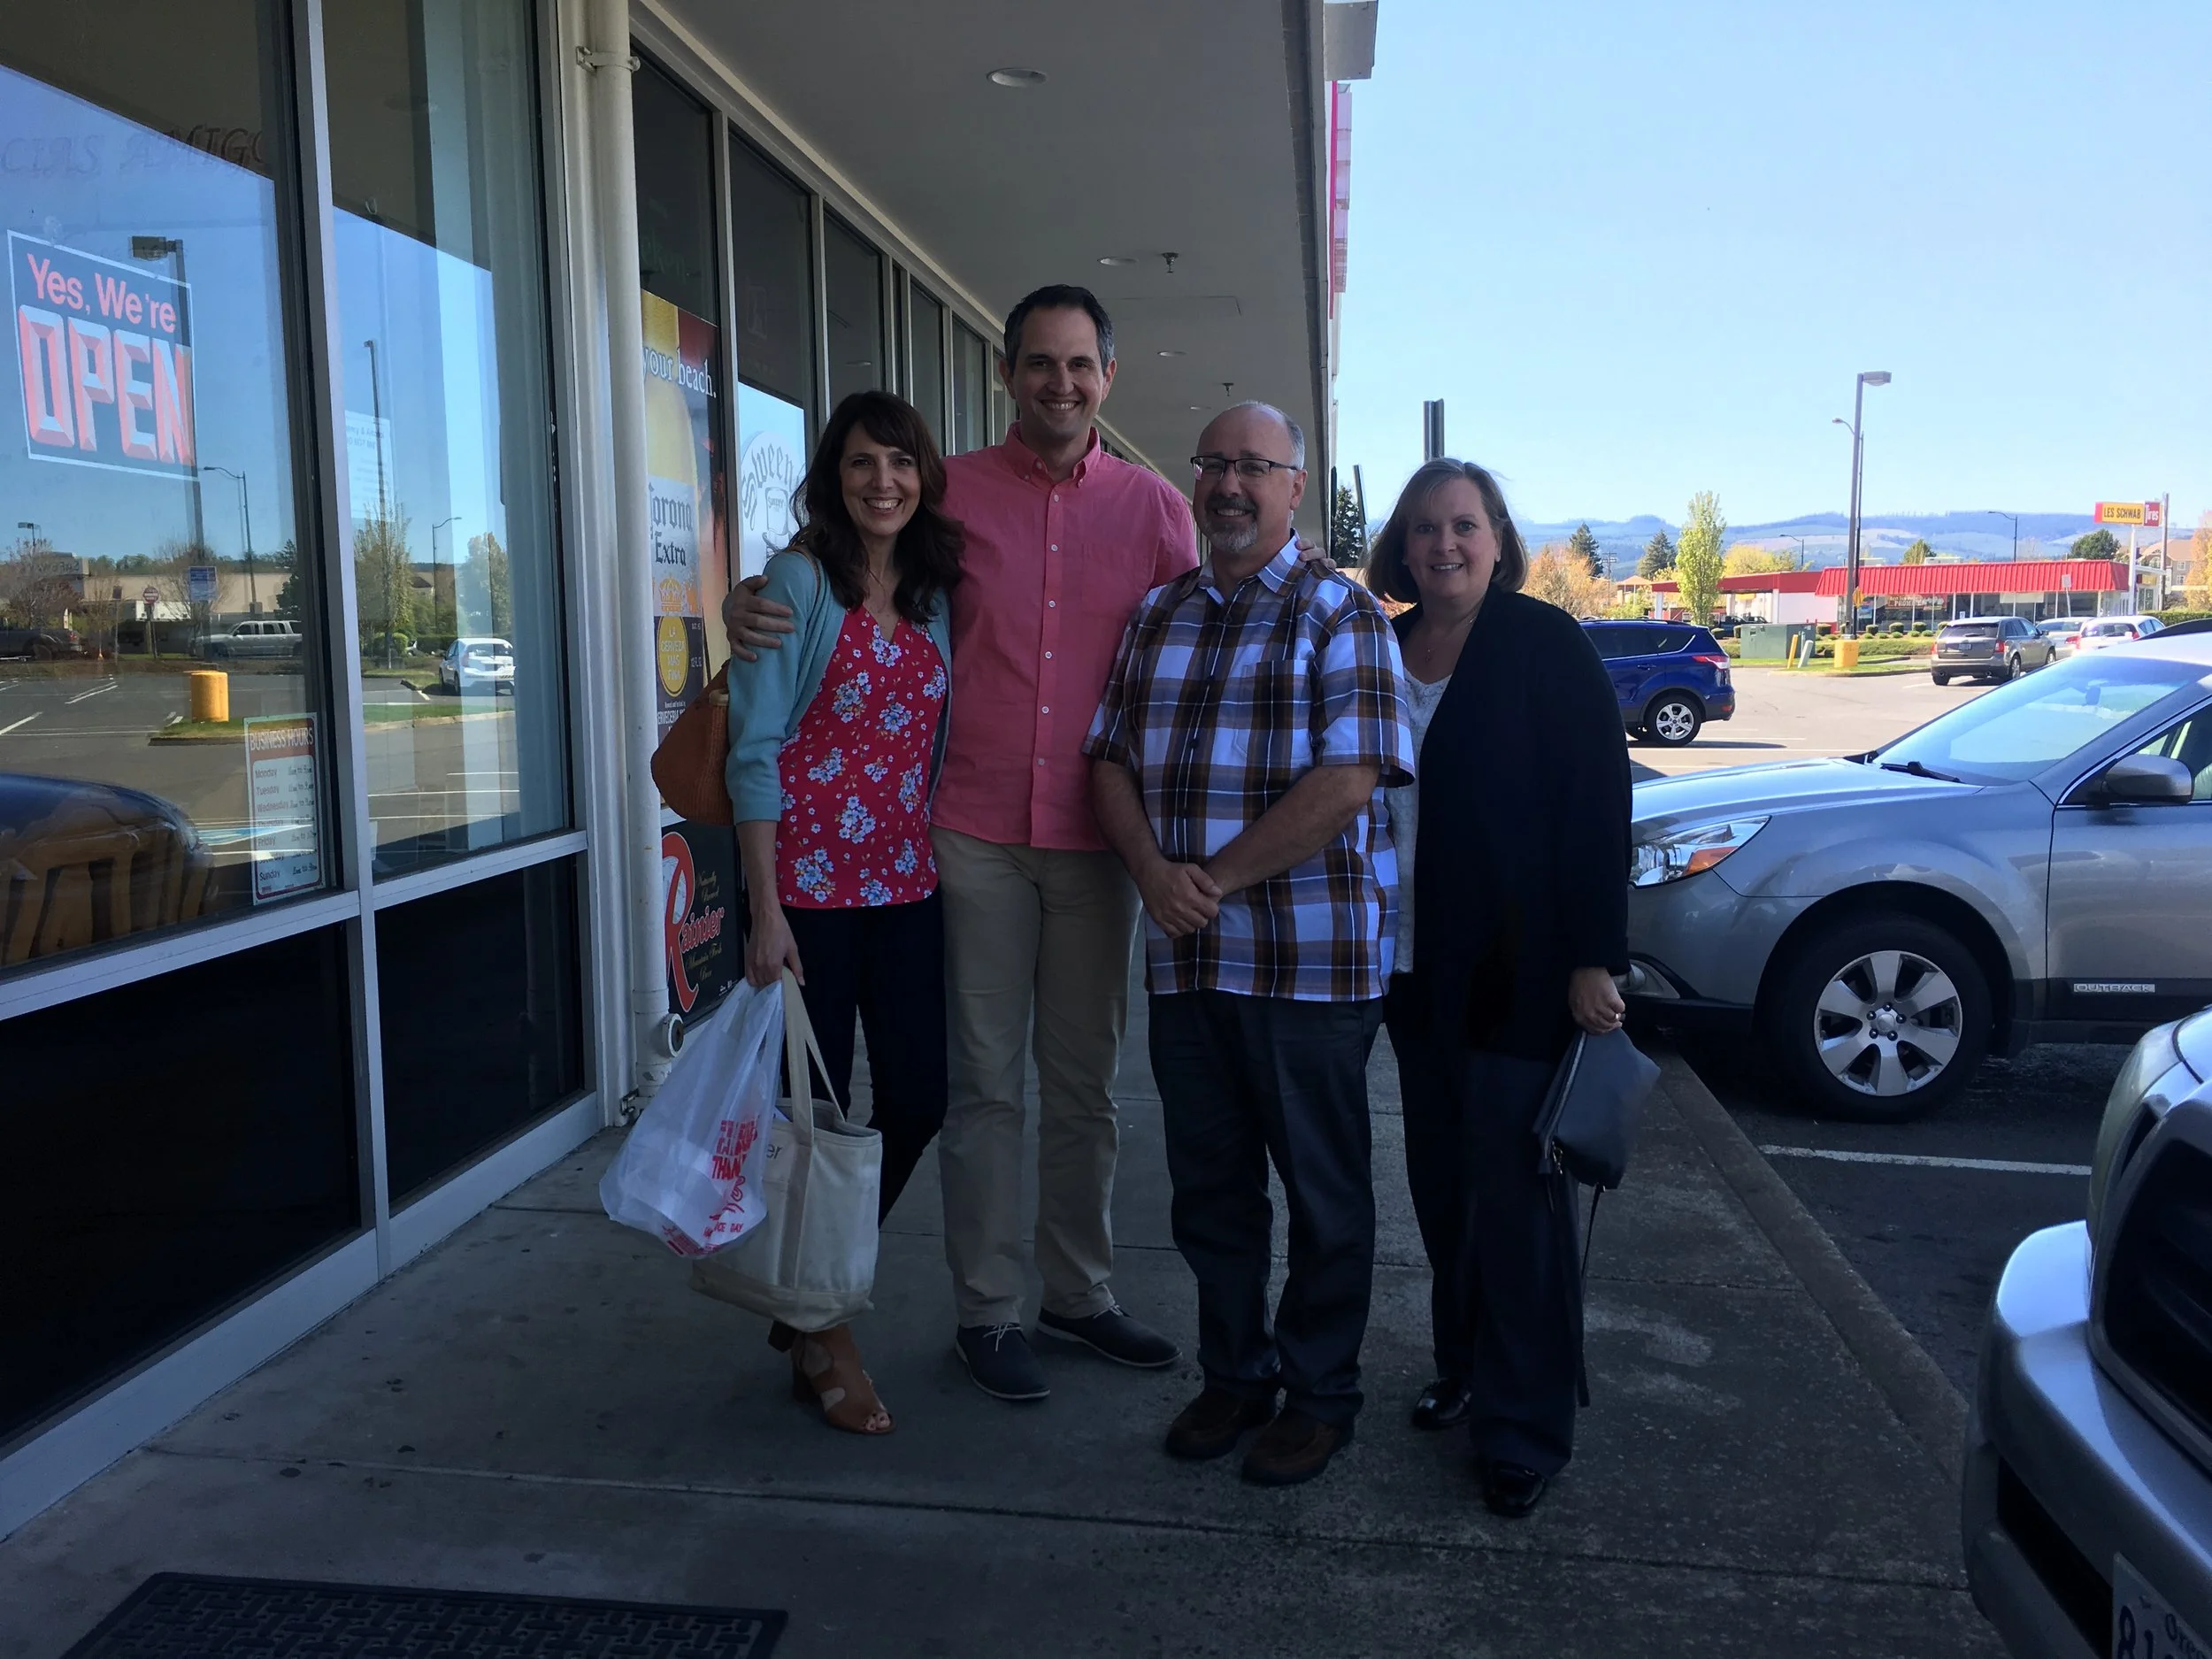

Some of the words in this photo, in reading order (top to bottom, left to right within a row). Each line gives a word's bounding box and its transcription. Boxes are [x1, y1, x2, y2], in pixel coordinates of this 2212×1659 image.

[27, 253, 90, 315] Yes,
[94, 272, 177, 334] We're
[642, 347, 673, 381] your
[676, 348, 718, 399] beach.
[19, 304, 196, 467] OPEN
[2104, 507, 2115, 518] LES
[2116, 507, 2141, 519] SCHWAB
[2145, 503, 2159, 524] Tires
[653, 531, 687, 567] Extra
[249, 730, 287, 751] BUSINESS
[288, 727, 314, 747] HOURS
[255, 768, 277, 780] Monday
[256, 785, 280, 797] Tuesday
[257, 799, 288, 813] Wednesday
[257, 834, 277, 847] Friday
[259, 870, 281, 881] Sunday
[2075, 983, 2154, 994] OUTBACK
